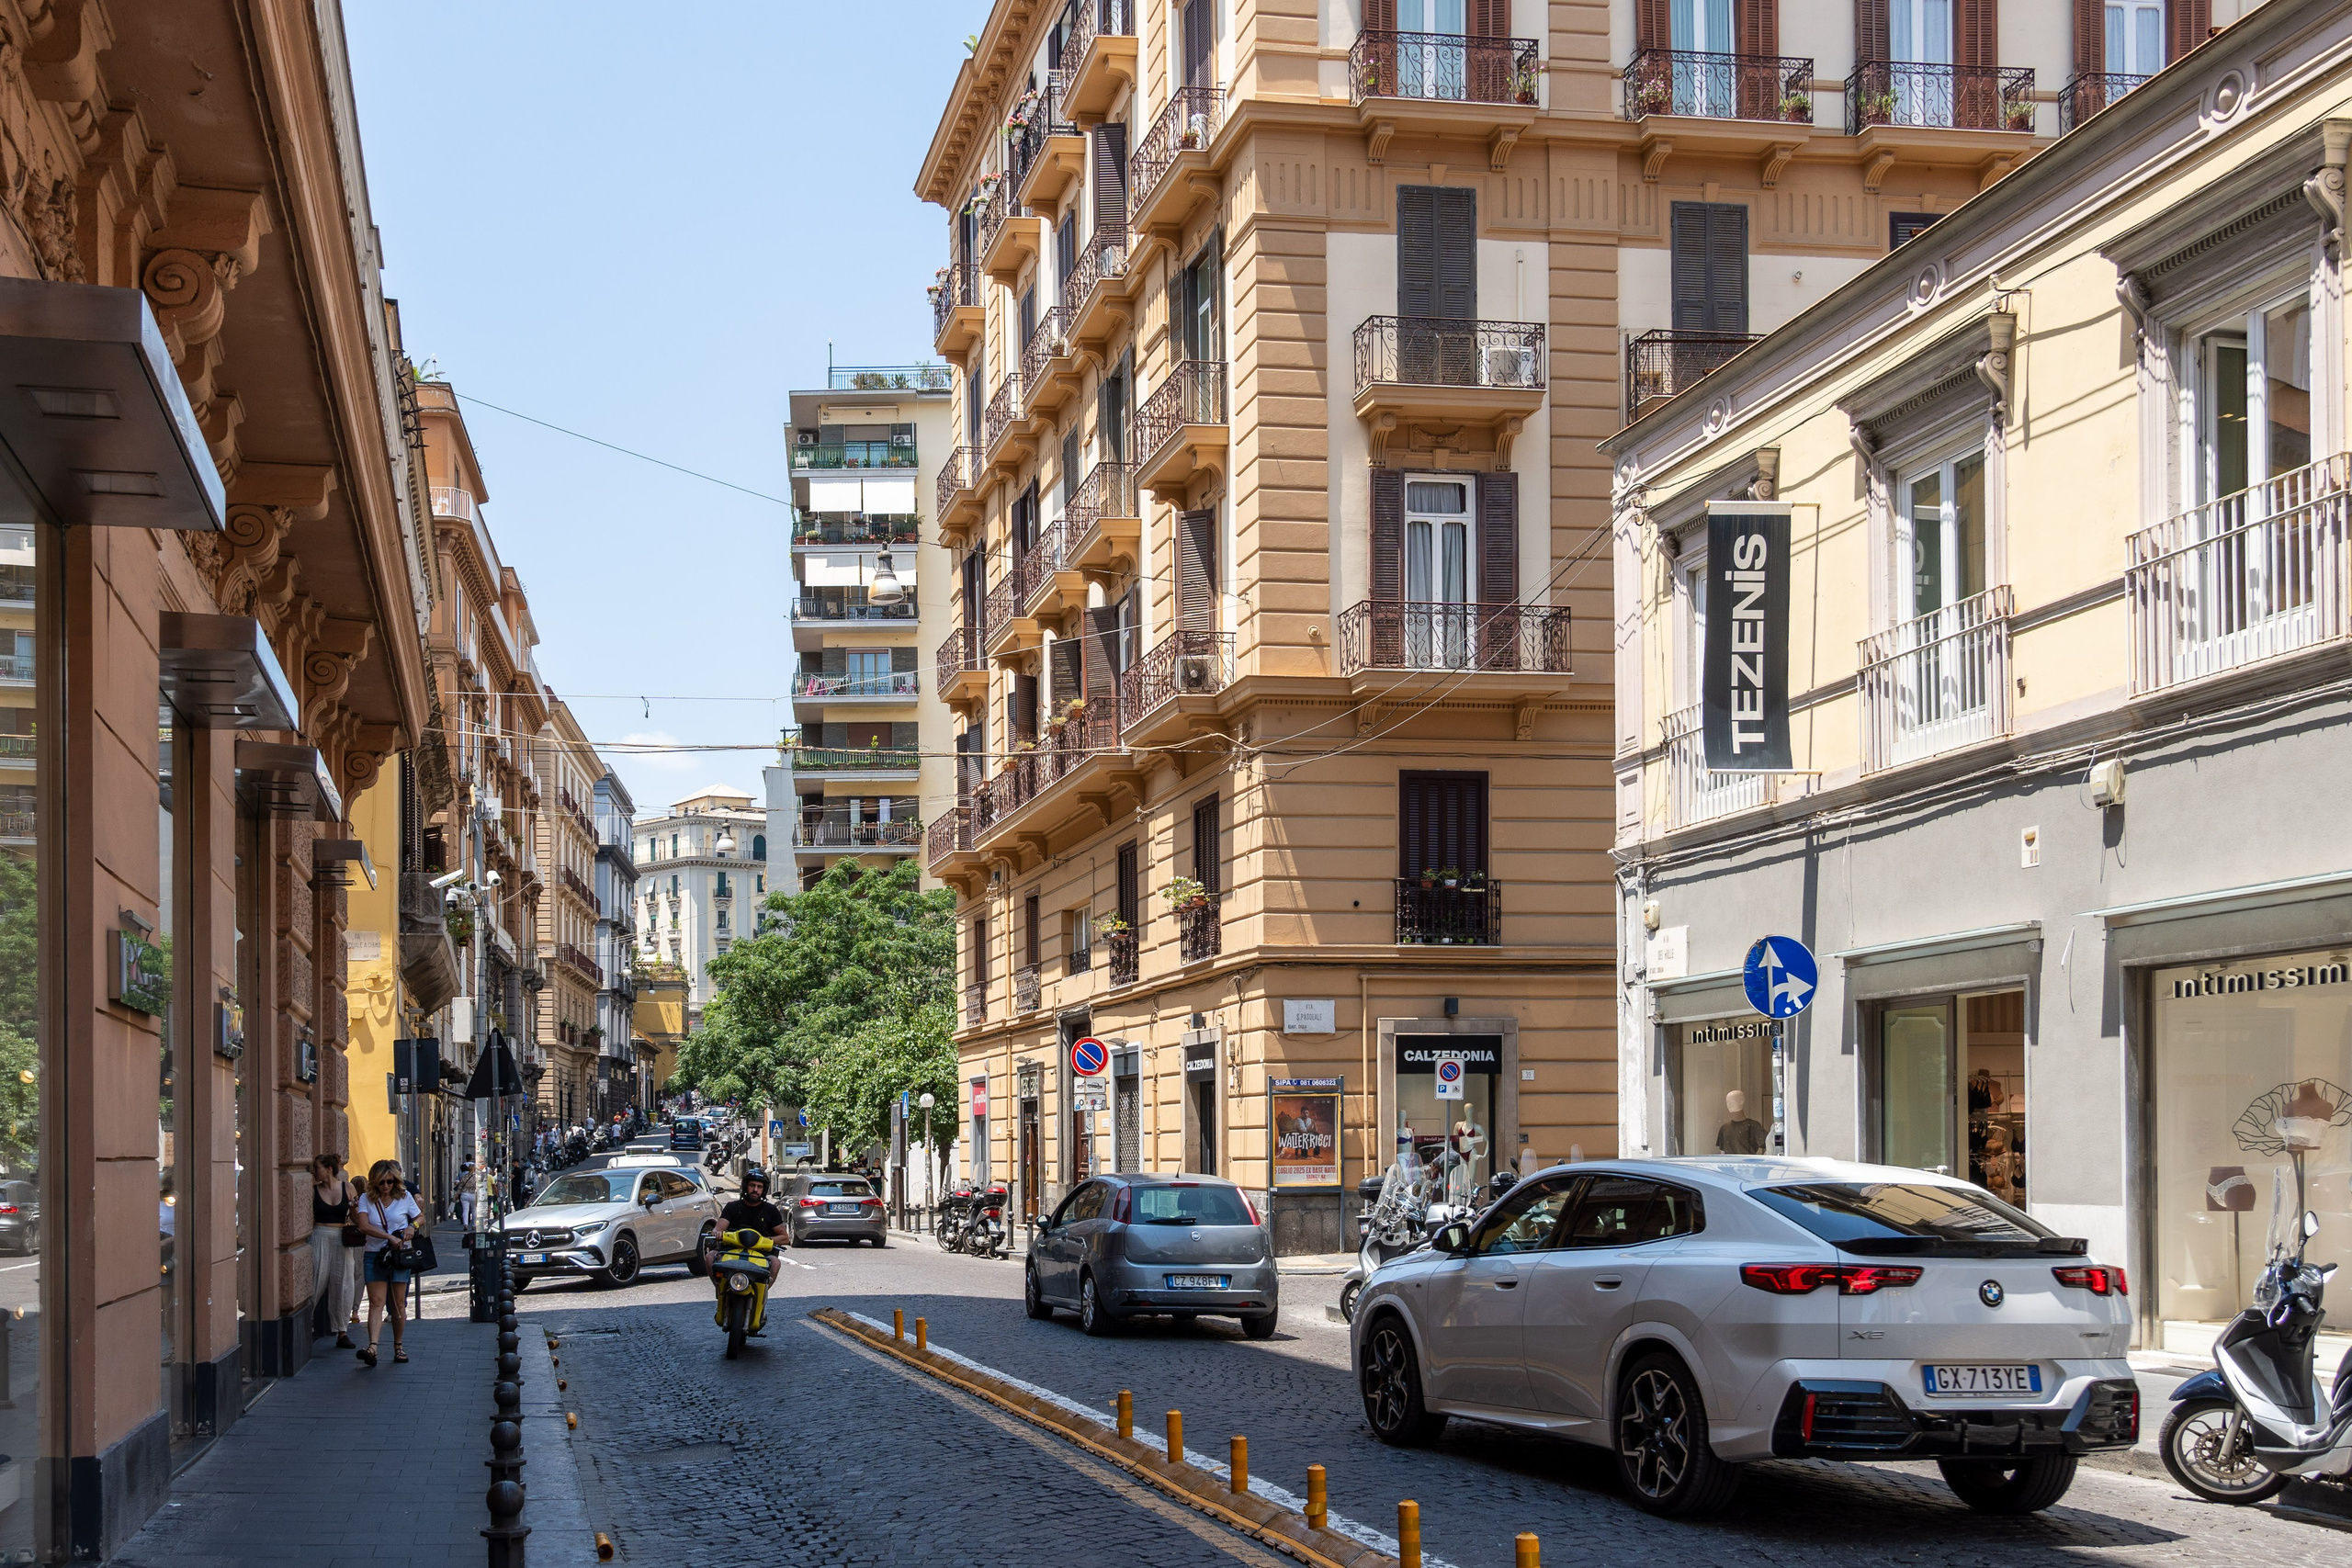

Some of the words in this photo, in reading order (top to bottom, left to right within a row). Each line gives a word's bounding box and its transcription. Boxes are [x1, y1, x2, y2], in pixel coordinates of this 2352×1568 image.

[2173, 963, 2352, 998] intimissim
[1691, 1021, 1773, 1044] intimissim
[1404, 1050, 1496, 1062] CALZEDONIA
[1186, 1057, 1215, 1072] CALZEDONIA
[1279, 1133, 1308, 1149] WALTER
[1309, 1134, 1331, 1148] RICCI
